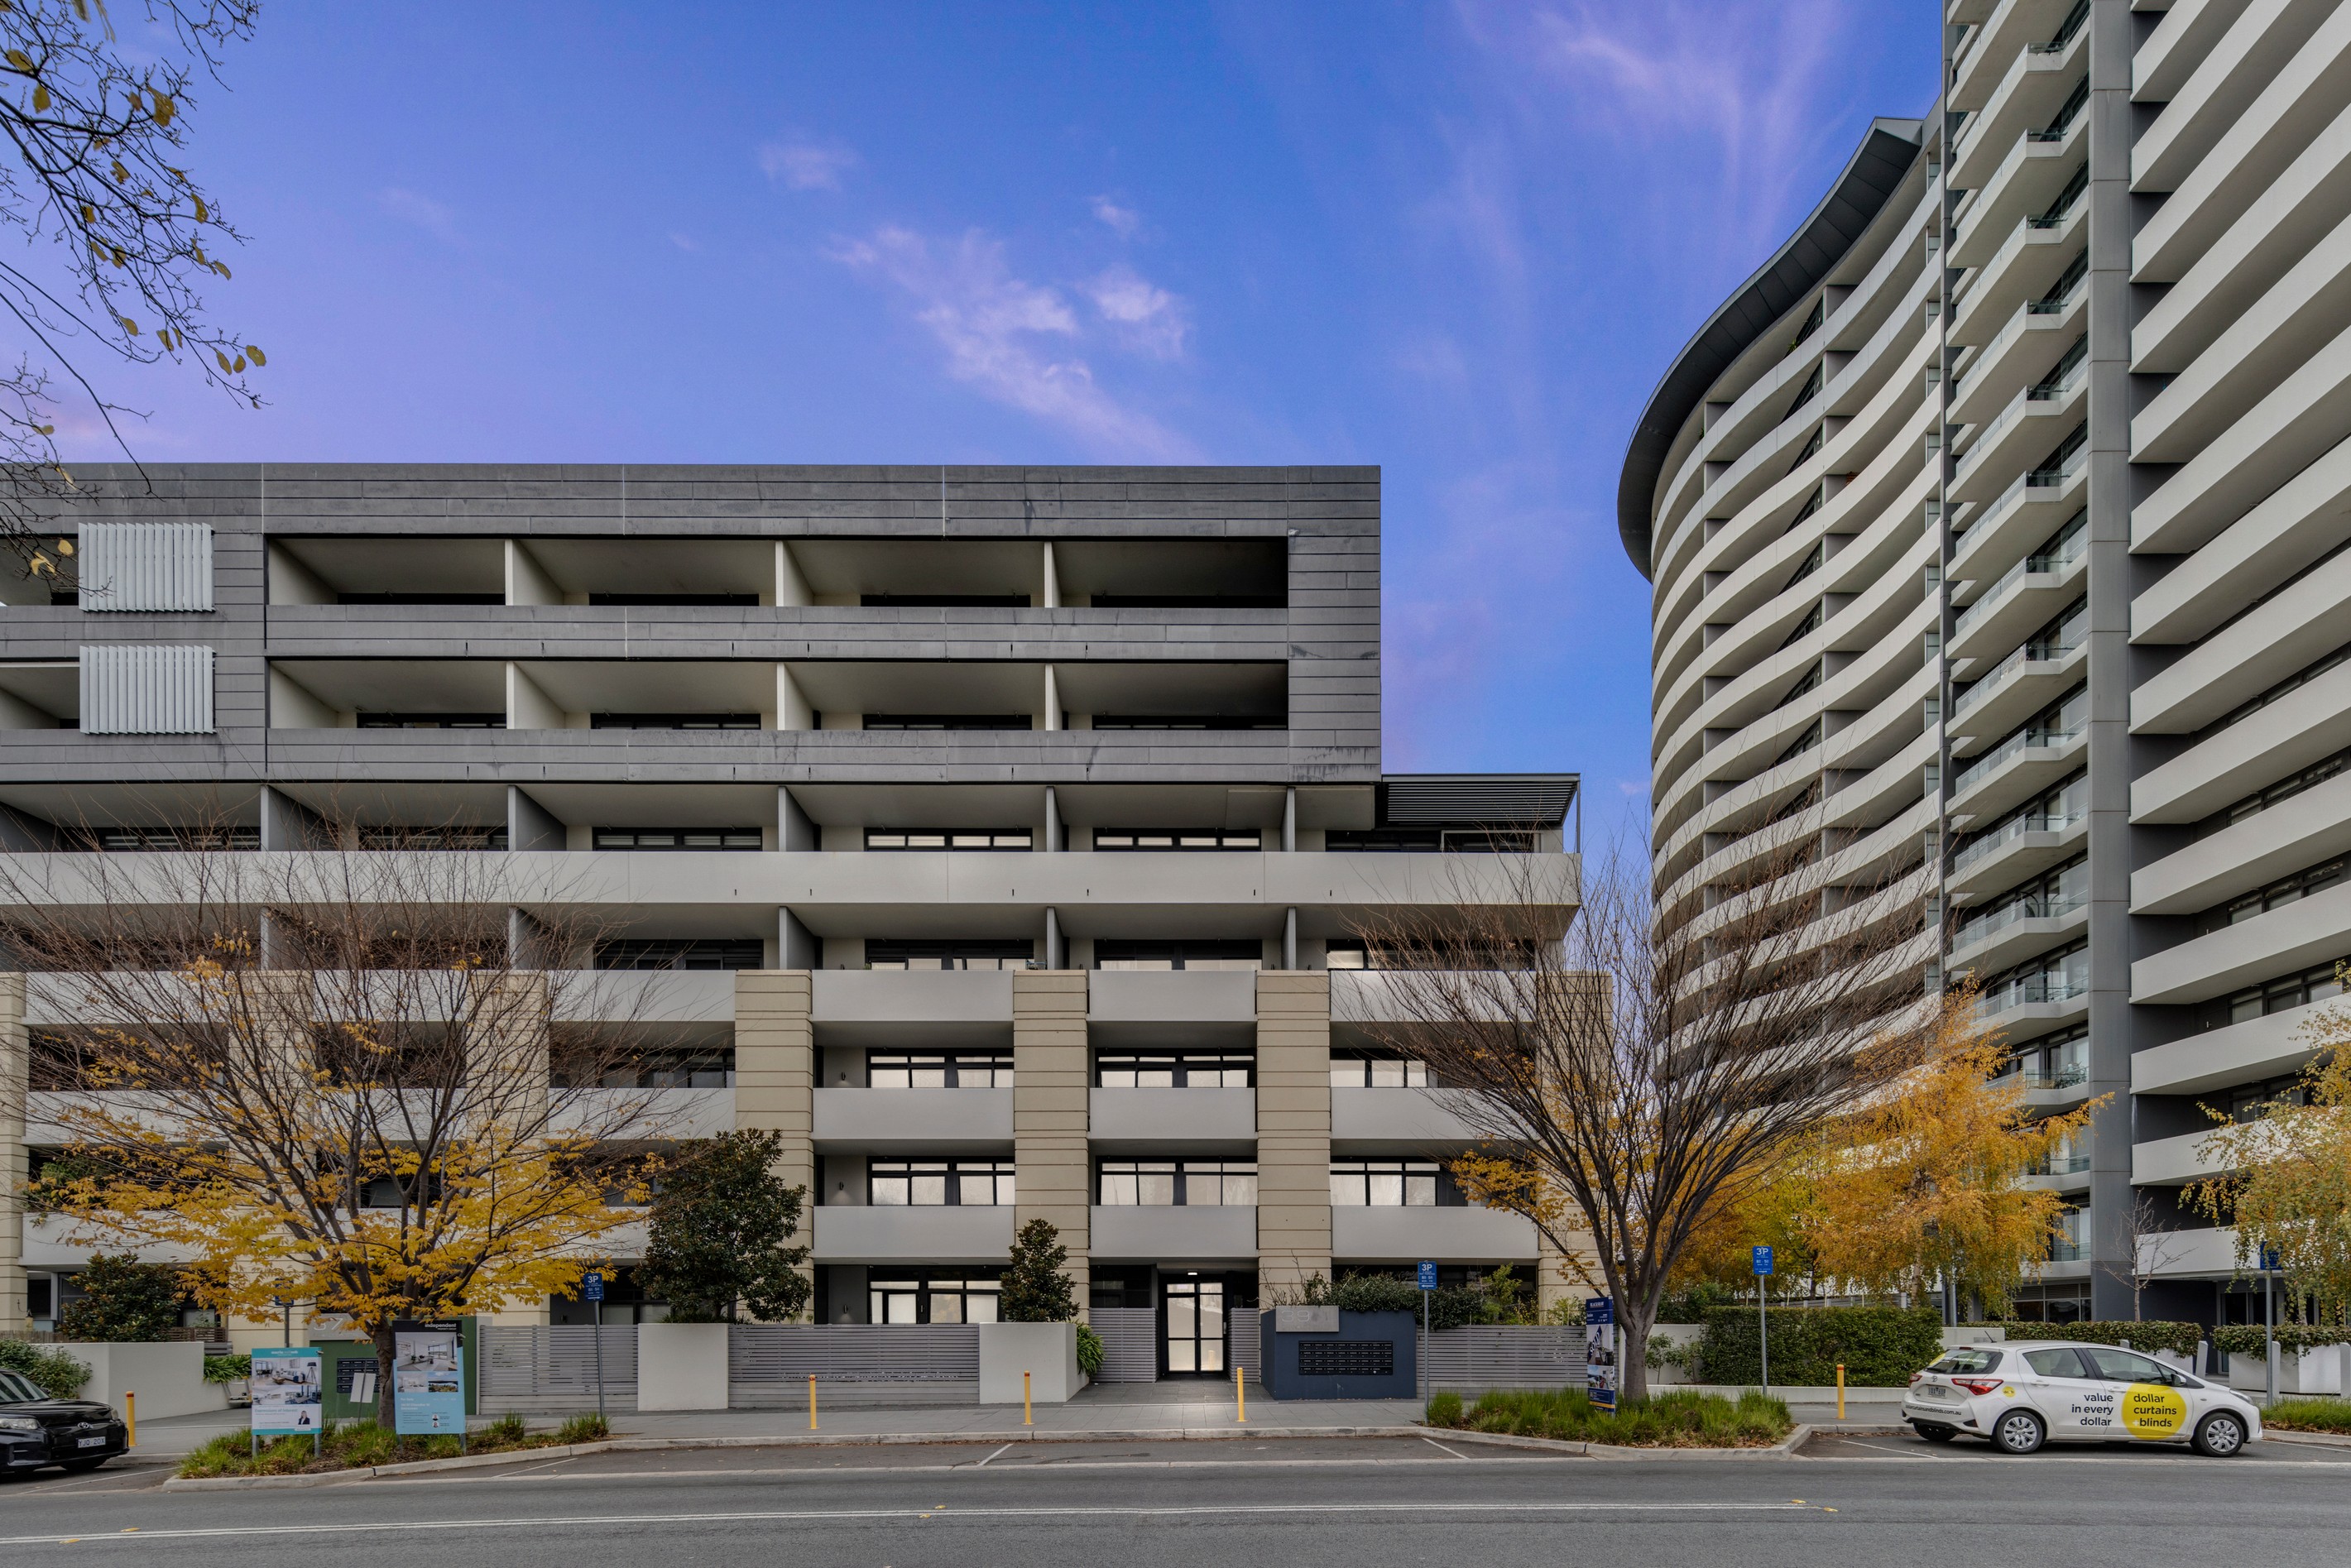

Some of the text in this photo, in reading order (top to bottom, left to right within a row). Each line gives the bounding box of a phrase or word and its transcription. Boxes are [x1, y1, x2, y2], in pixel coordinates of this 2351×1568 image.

[588, 1275, 599, 1283] 3P
[1282, 1310, 1310, 1322] 39
[1590, 1331, 1601, 1356] SOLD
[2084, 1393, 2114, 1402] value
[2133, 1393, 2165, 1403] dollar
[2071, 1404, 2114, 1415] in every
[2133, 1406, 2177, 1415] curtains
[2080, 1417, 2112, 1426] dollar
